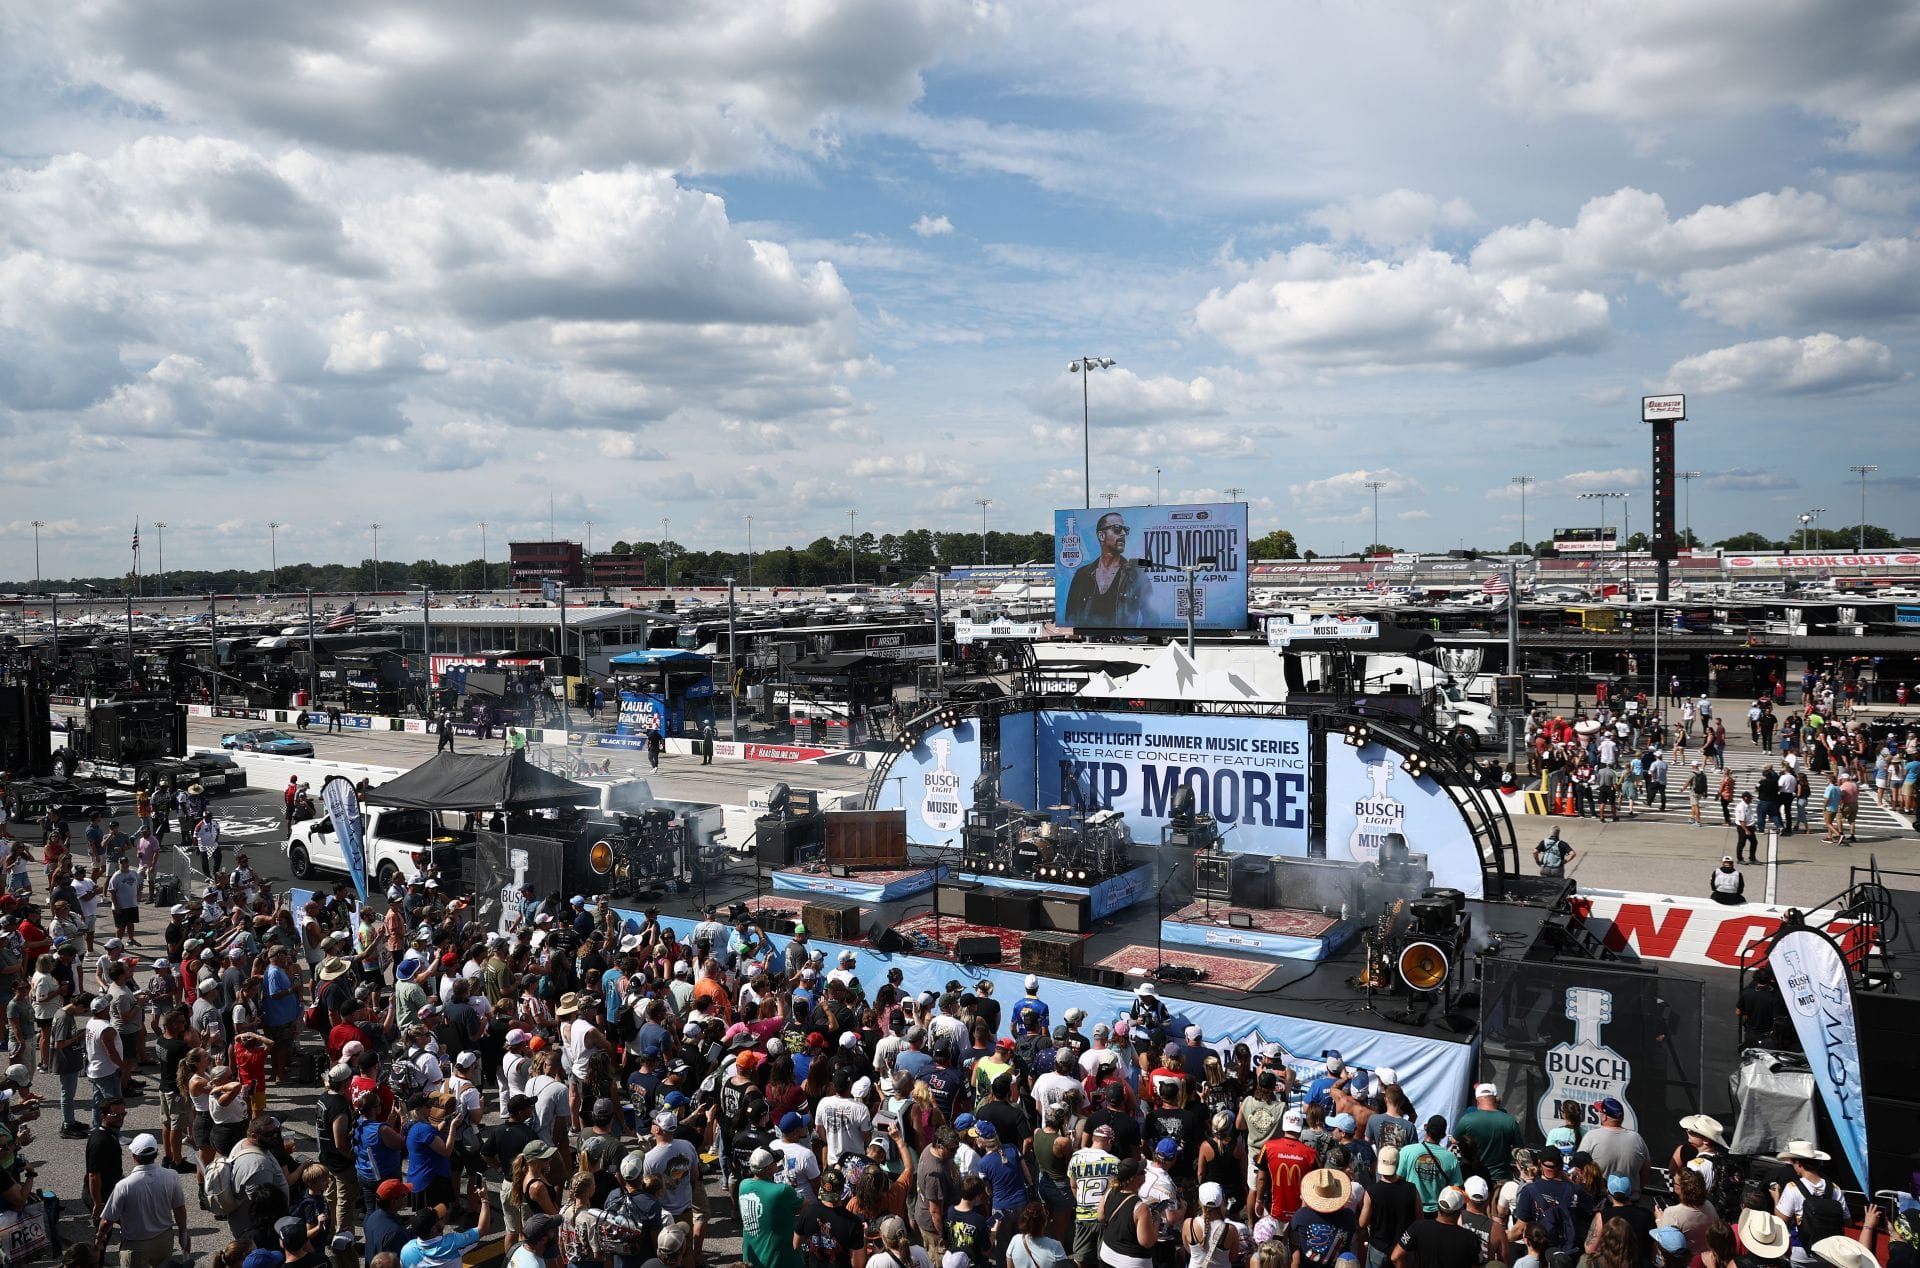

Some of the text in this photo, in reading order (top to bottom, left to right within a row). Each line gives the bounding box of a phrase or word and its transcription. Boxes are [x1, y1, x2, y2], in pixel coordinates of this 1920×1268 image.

[1061, 535, 1081, 544] BUSCH
[1144, 529, 1237, 572] KIP MOORE
[1776, 557, 1840, 566] COOK
[1843, 556, 1887, 565] OUT
[991, 627, 1011, 635] MUSIC
[1313, 626, 1338, 635] MUSIC
[879, 636, 900, 647] NASCAR
[620, 701, 653, 713] KAULIG
[258, 710, 267, 720] 44
[345, 716, 356, 725] Life
[619, 712, 653, 724] RACING
[601, 738, 626, 746] BLACK'S
[1063, 731, 1300, 755] BUSCH LIGHT SUMMER MUSIC SERIES
[847, 753, 861, 765] 41
[1063, 748, 1304, 770] PRE RACE CONCERT FEATURING
[925, 774, 960, 788] BUSCH
[1058, 759, 1304, 829] KIP MOORE
[927, 801, 958, 814] MUSIC
[1355, 802, 1404, 818] BUSCH
[1365, 817, 1394, 825] LIGHT
[1363, 825, 1396, 833] SUMMER
[502, 889, 520, 904] BUS
[1548, 1051, 1627, 1082] BUSCH
[1564, 1076, 1611, 1090] LIGHT
[1076, 1177, 1109, 1206] 12
